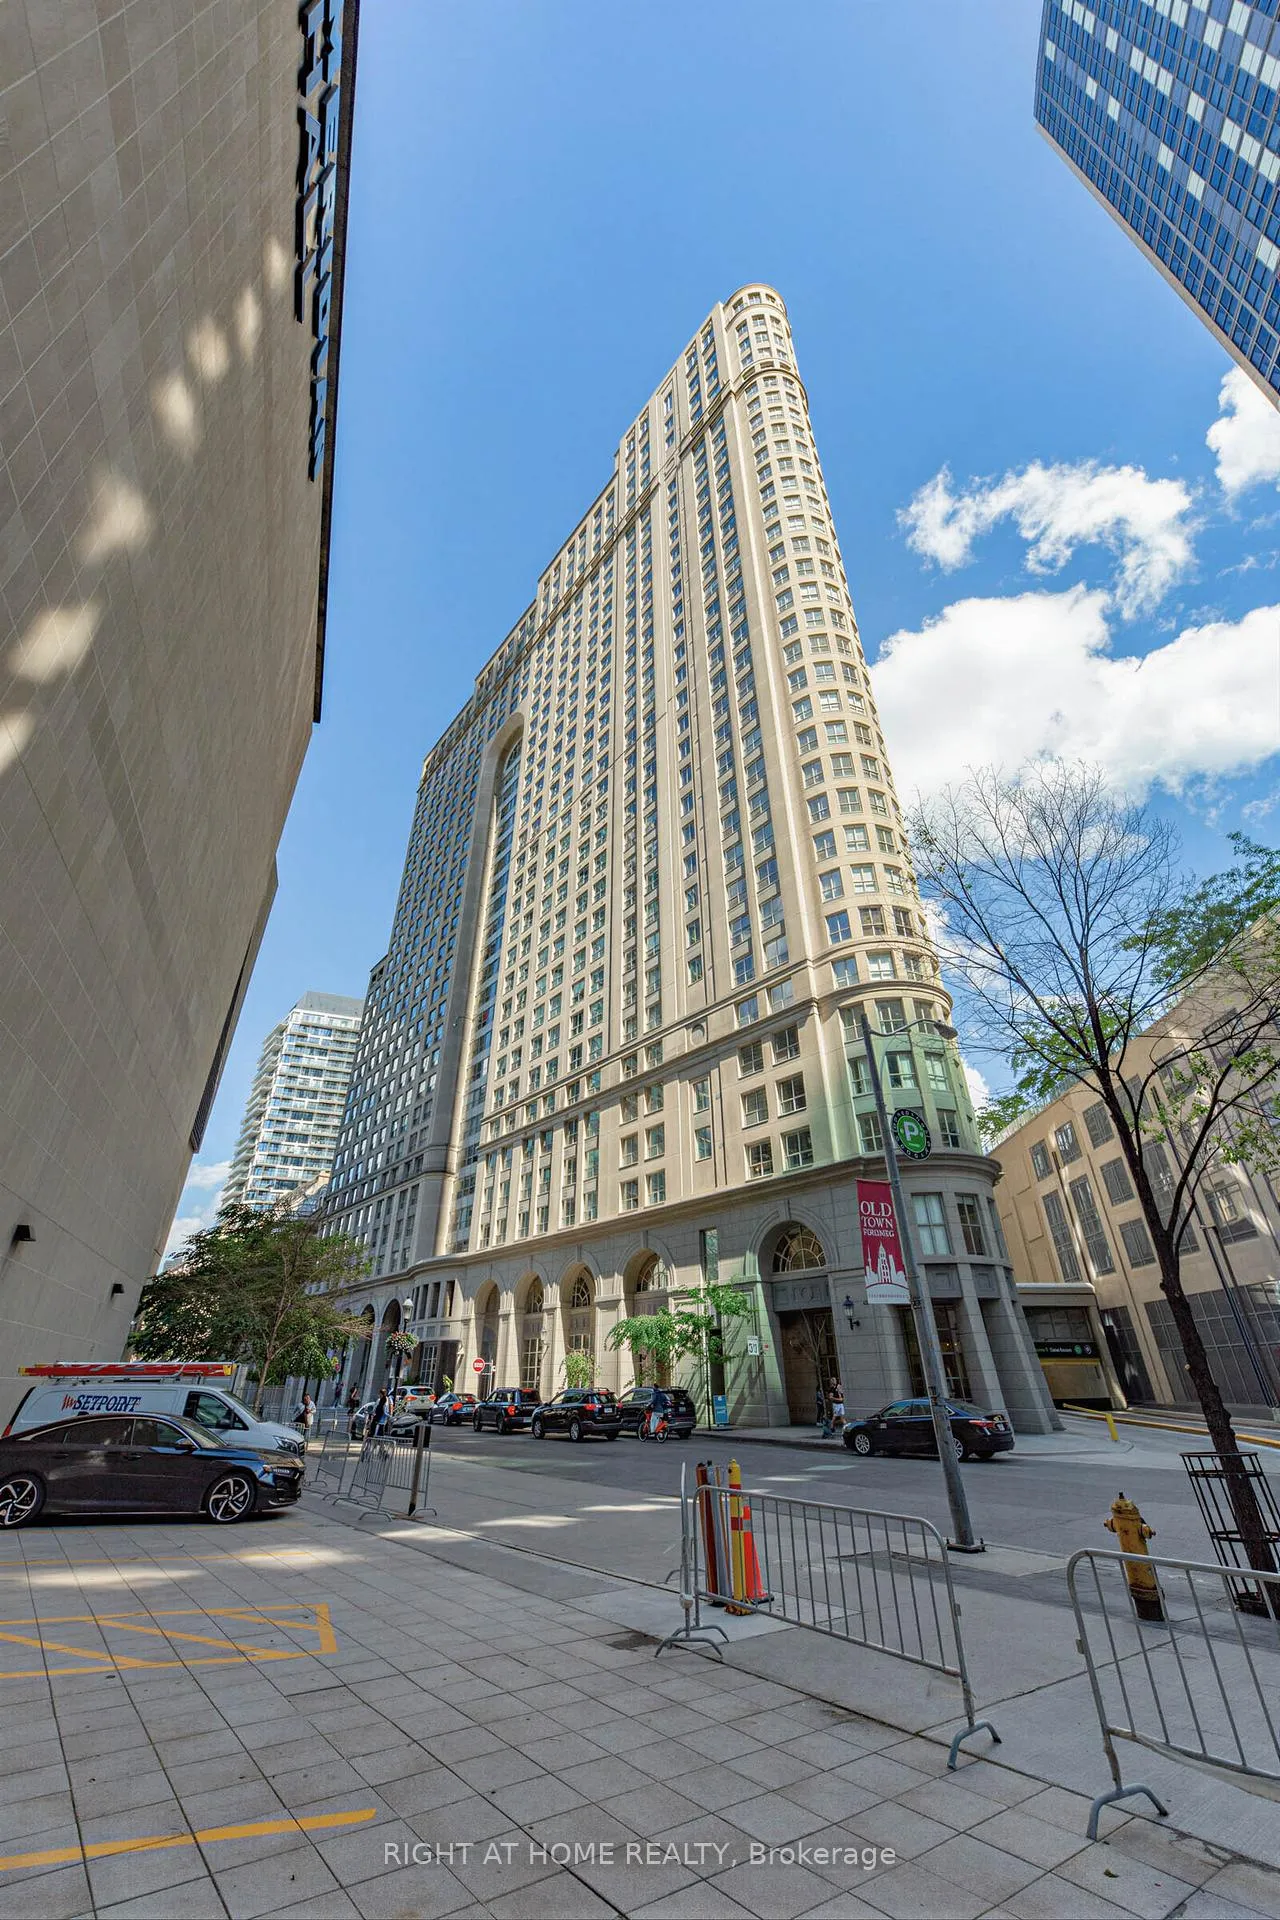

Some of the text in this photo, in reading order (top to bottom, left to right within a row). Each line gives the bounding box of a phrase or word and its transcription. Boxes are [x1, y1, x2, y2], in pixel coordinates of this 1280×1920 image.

[903, 1121, 919, 1141] P
[860, 1200, 892, 1217] OLD
[861, 1215, 893, 1229] TOWN
